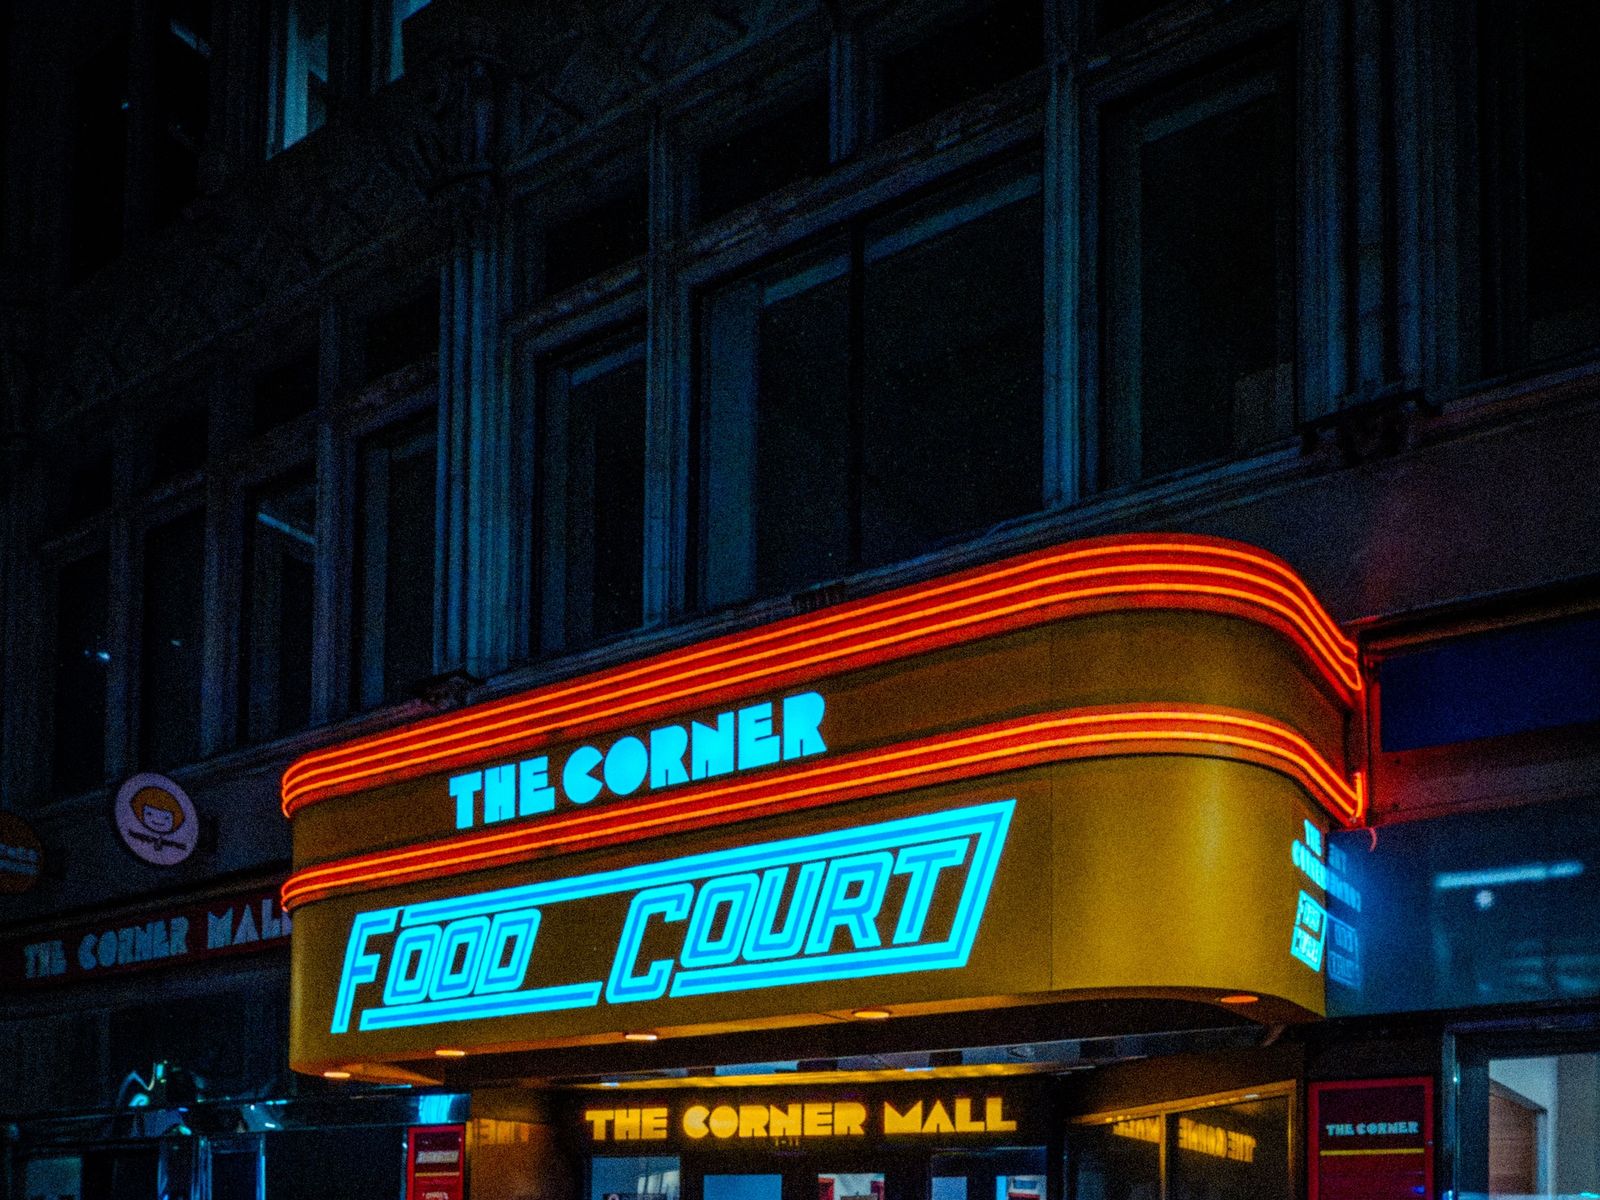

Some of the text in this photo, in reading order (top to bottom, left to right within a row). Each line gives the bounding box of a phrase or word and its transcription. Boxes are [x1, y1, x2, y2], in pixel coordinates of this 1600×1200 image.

[449, 691, 827, 829] THE CORNER
[78, 916, 189, 970] CORNER
[331, 826, 980, 1034] FOOD COURT
[586, 1097, 1017, 1140] THE CORNER MALL
[1326, 1121, 1419, 1136] THE CORNER
